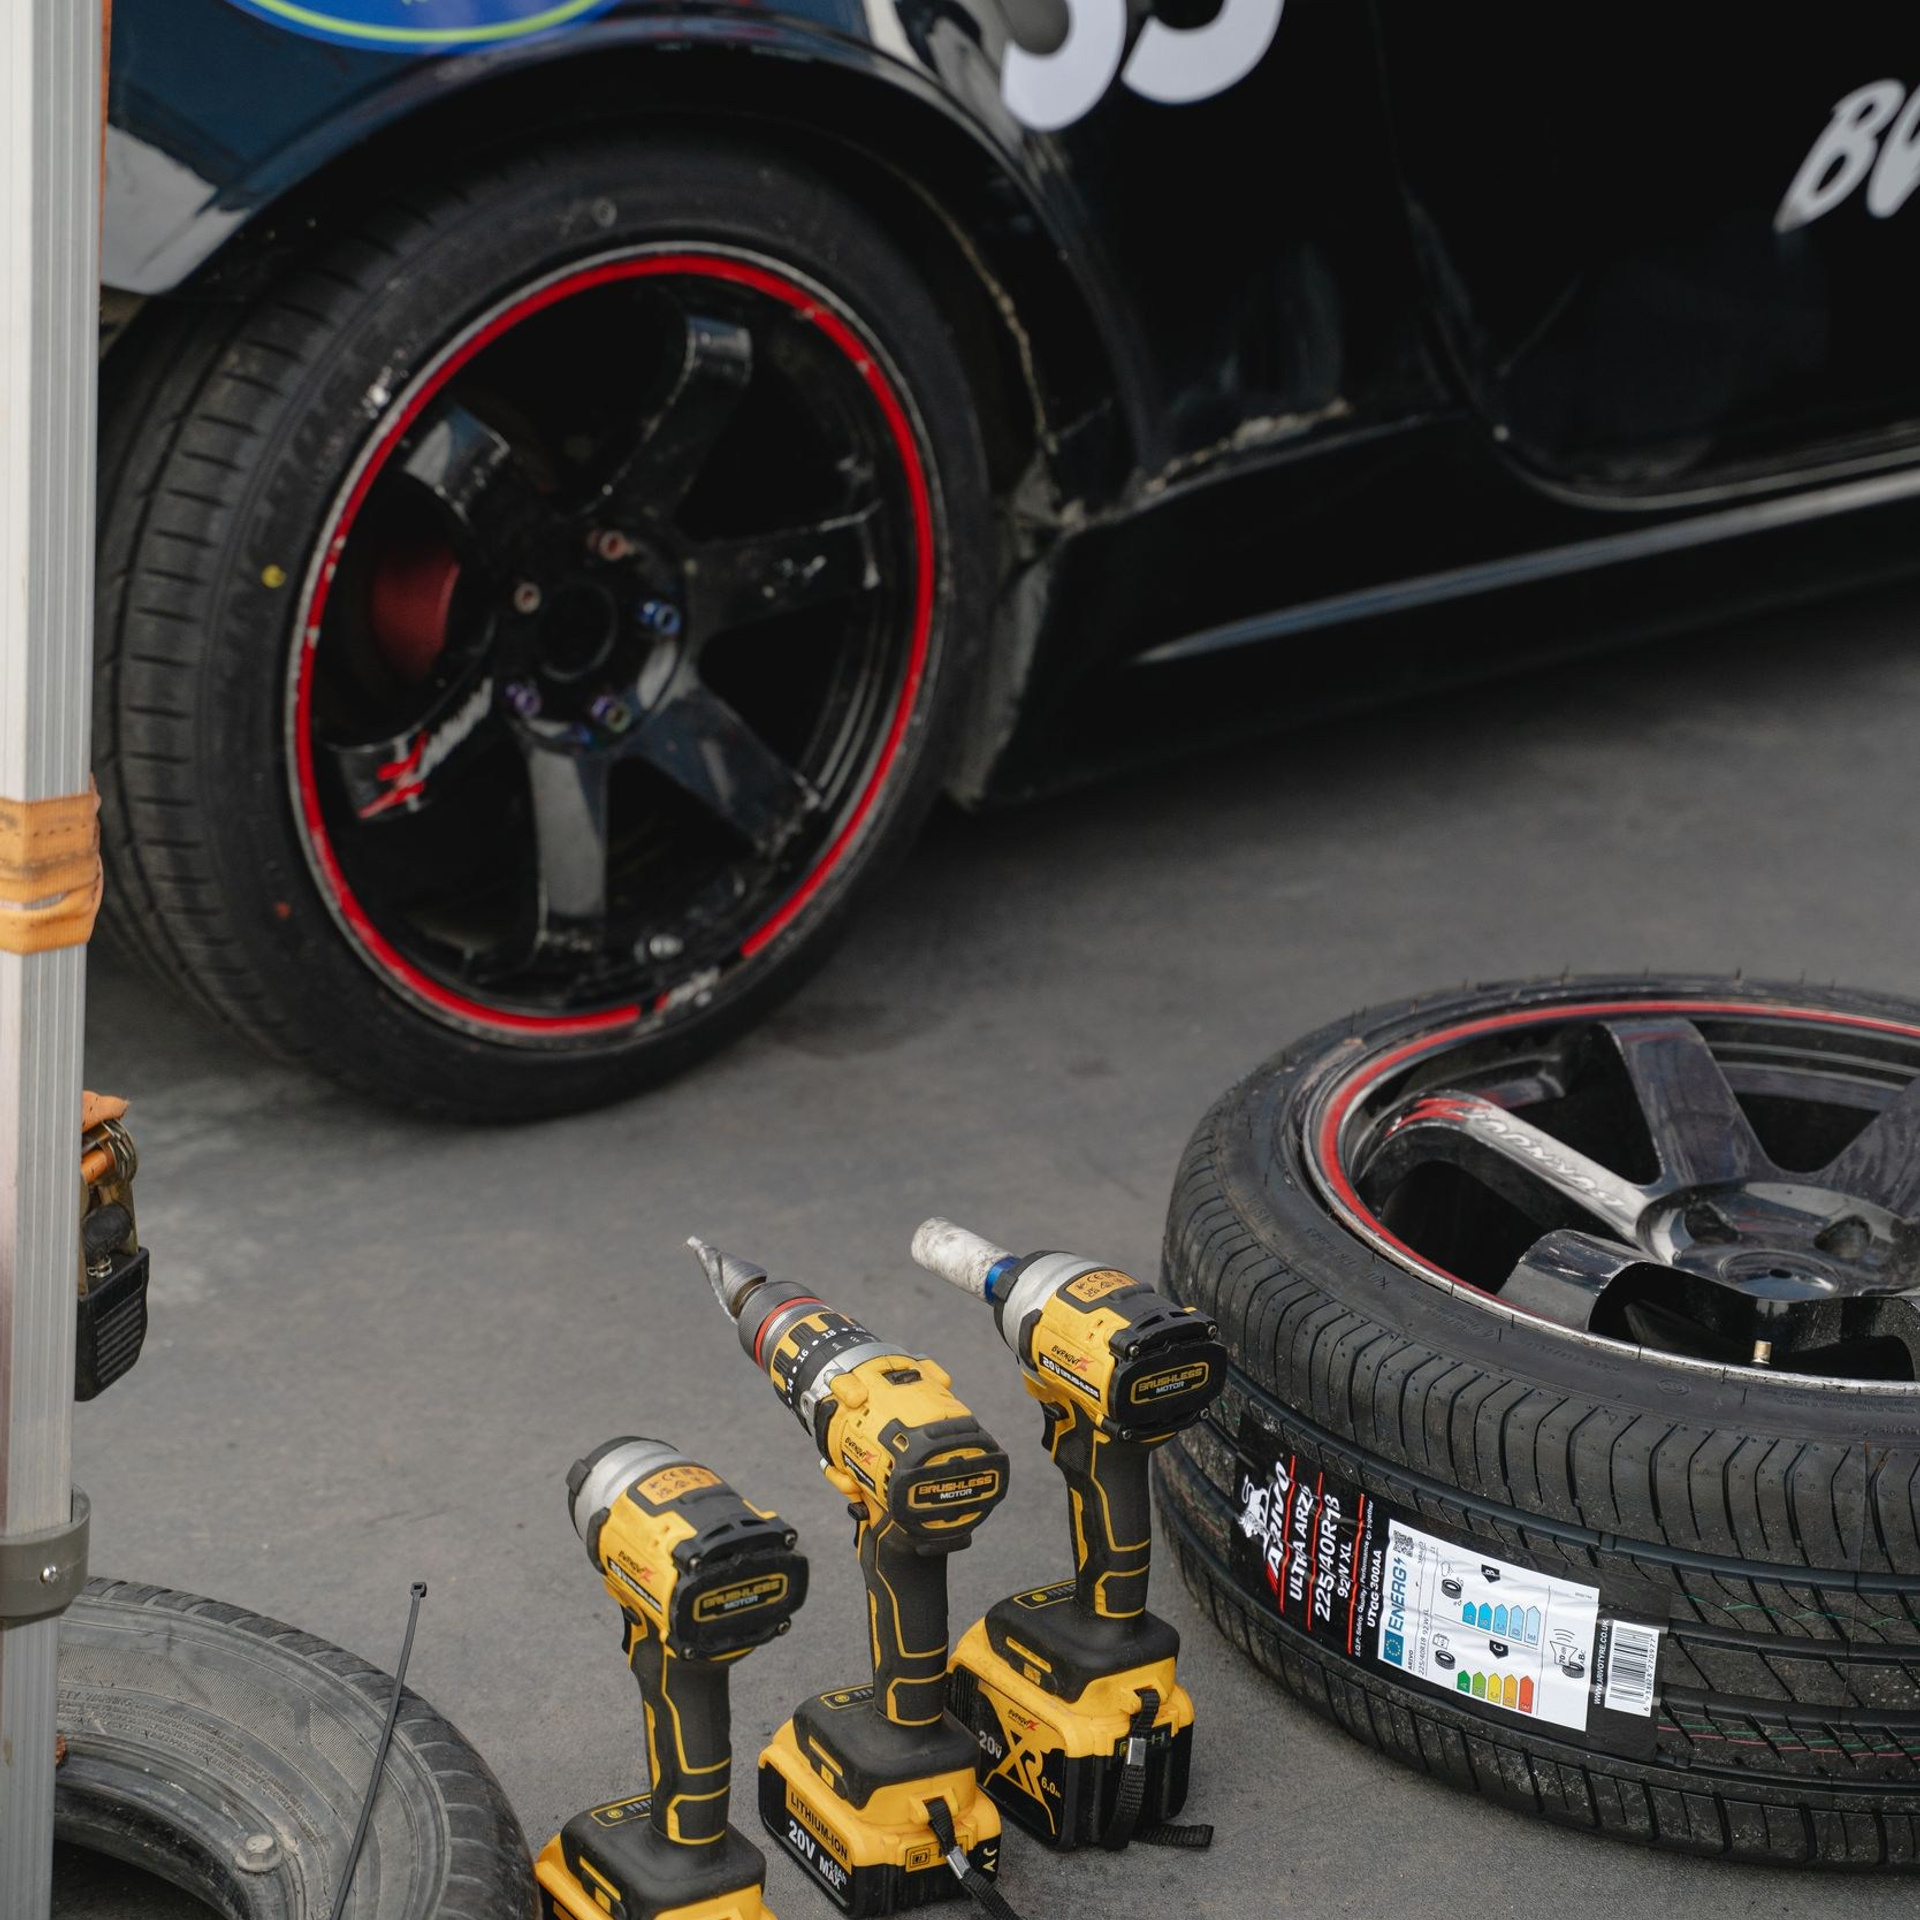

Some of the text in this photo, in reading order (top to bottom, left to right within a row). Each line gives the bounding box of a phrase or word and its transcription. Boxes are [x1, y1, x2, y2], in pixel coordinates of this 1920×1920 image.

[822, 1329, 837, 1340] 18
[797, 1348, 810, 1363] 16
[1138, 1367, 1203, 1392] BRUSHLESS
[1155, 1381, 1185, 1394] MOTOR
[918, 1475, 993, 1495] BRUSHLESS
[940, 1488, 972, 1499] MOTOR
[1314, 1493, 1341, 1622] 225/40R18
[1340, 1542, 1353, 1564] XL
[1289, 1540, 1308, 1601] ULTRA
[1367, 1550, 1383, 1628] UTQG 300AA
[790, 1792, 848, 1861] LITHIUM-ION
[788, 1819, 841, 1890] 20V MAX
